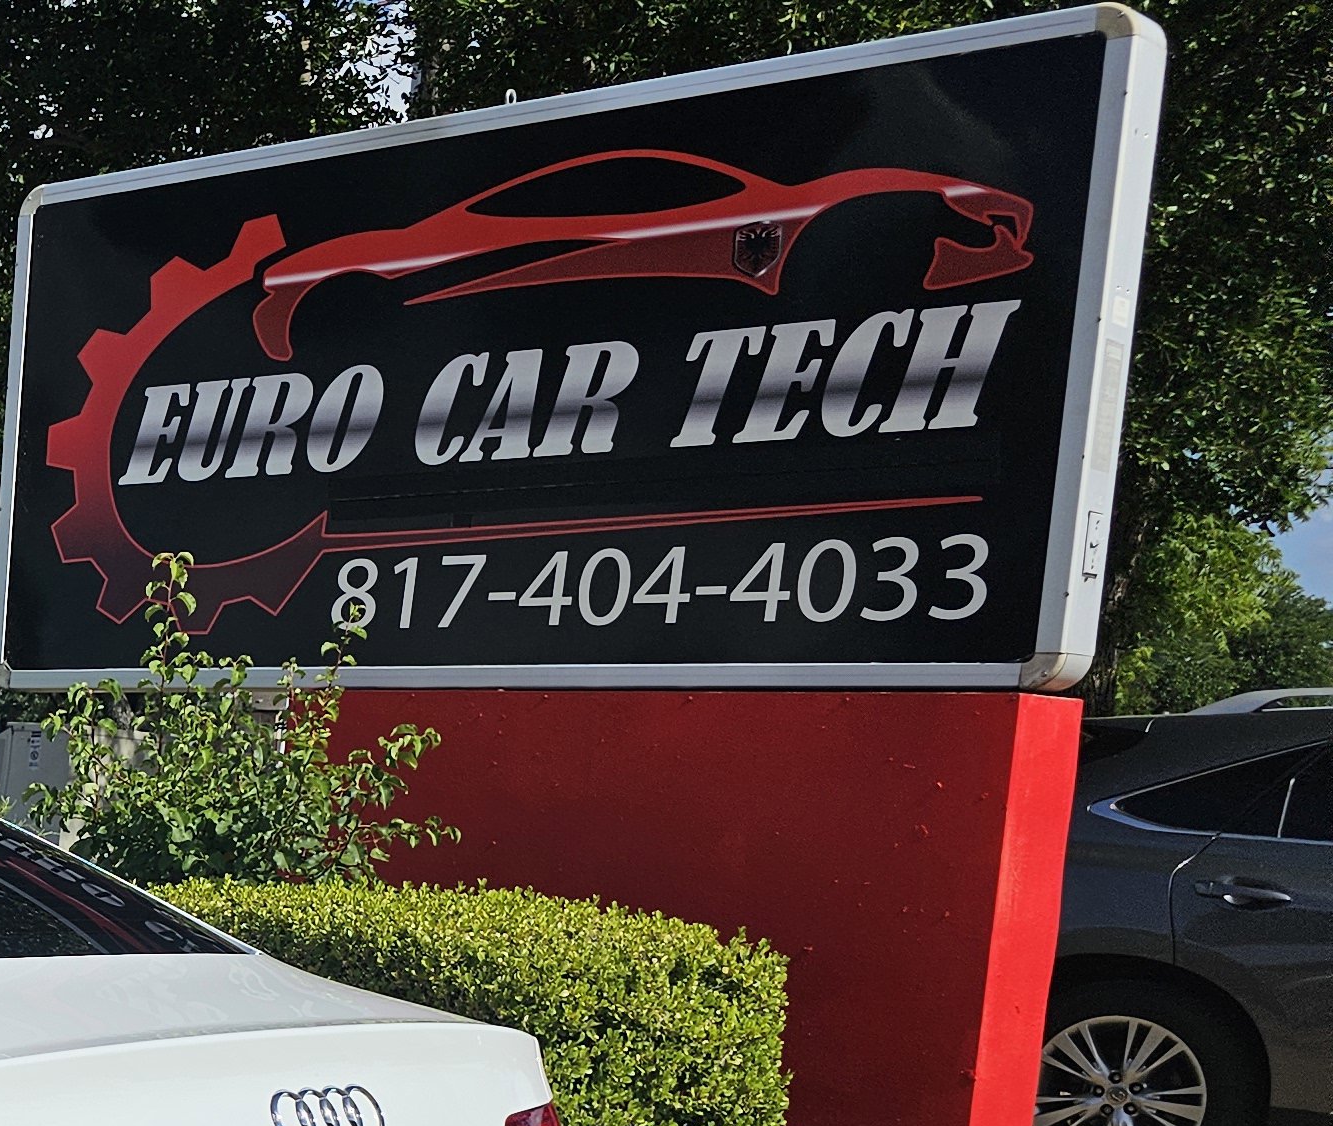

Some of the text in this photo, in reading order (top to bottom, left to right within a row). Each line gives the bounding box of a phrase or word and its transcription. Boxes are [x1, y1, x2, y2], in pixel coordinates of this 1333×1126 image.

[118, 300, 1021, 485] EURO CAR TECH
[331, 533, 989, 631] 817-404-4033
